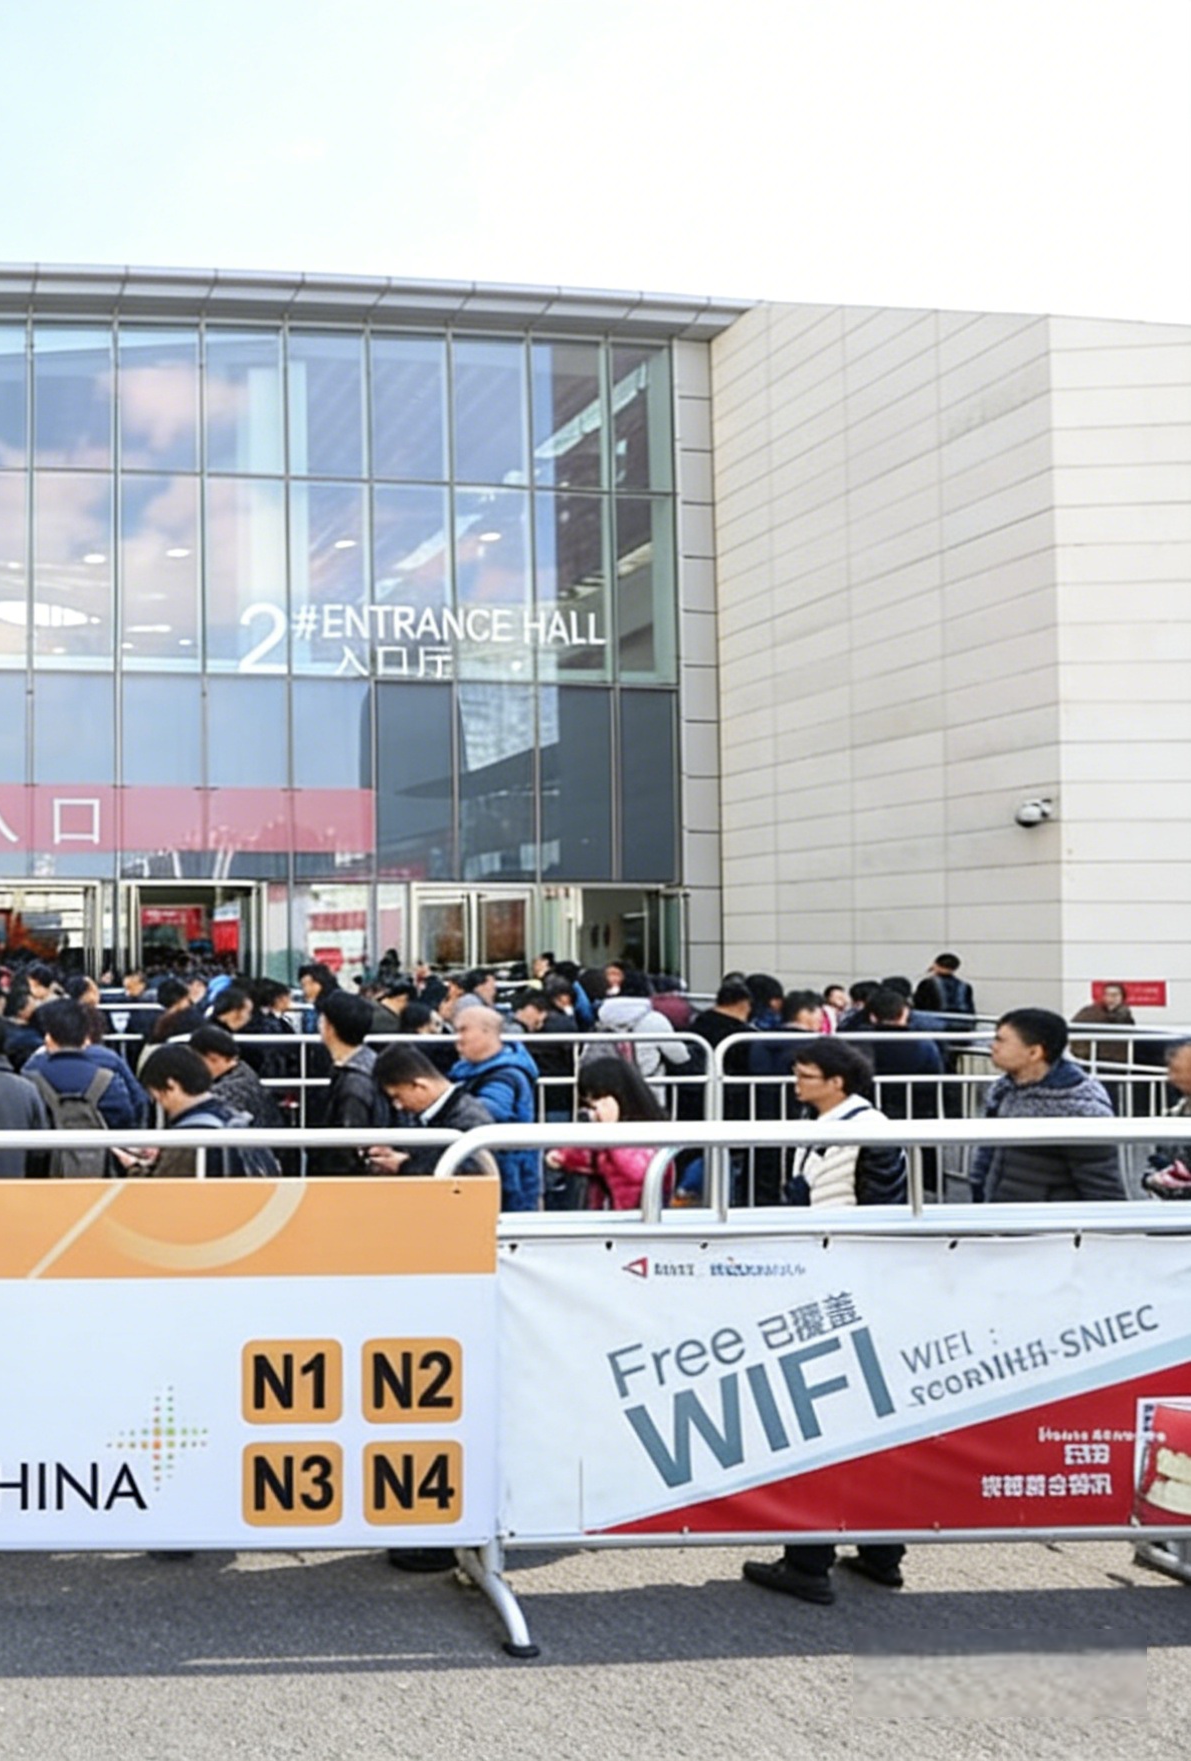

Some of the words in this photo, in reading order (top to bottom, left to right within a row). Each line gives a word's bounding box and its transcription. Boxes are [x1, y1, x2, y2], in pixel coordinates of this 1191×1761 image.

[322, 604, 511, 643] ENTRANCE
[522, 610, 606, 645] HALL
[335, 645, 453, 678] 入口厅
[253, 1352, 327, 1409] N1
[372, 1351, 455, 1408] N2
[606, 1327, 747, 1399] Free
[623, 1326, 897, 1488] WIFI
[253, 1456, 336, 1510] N3
[372, 1454, 455, 1509] N4
